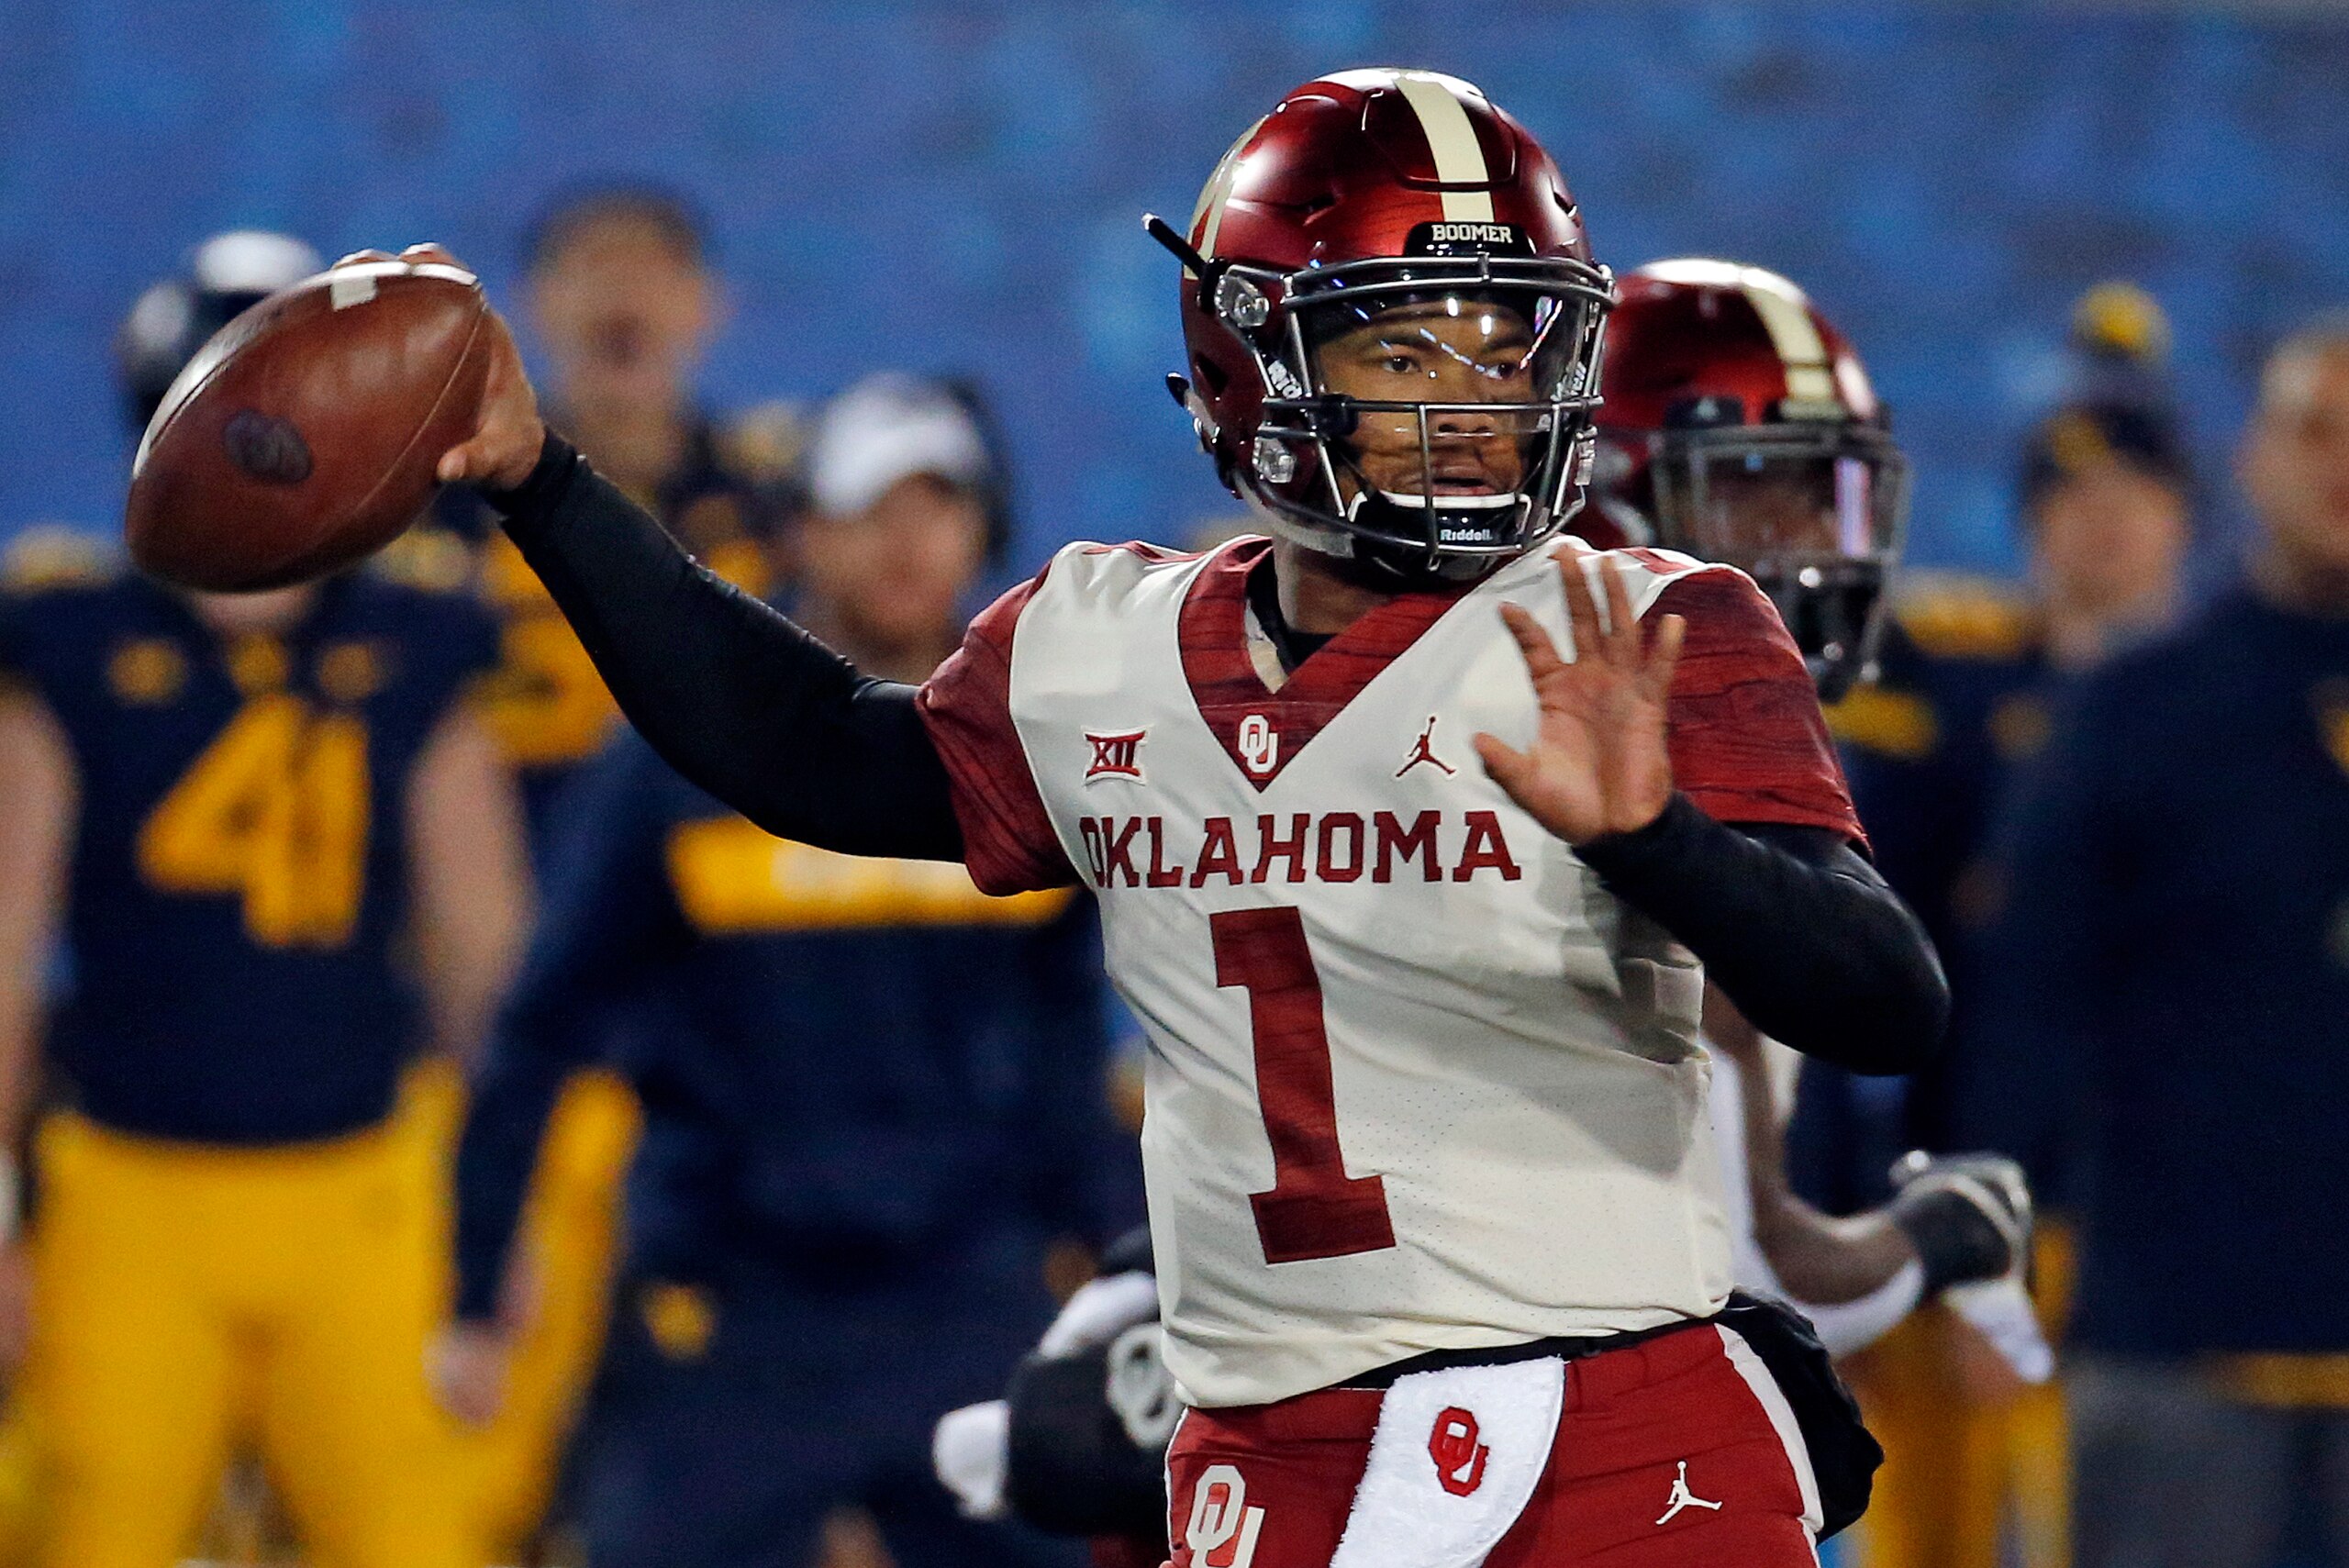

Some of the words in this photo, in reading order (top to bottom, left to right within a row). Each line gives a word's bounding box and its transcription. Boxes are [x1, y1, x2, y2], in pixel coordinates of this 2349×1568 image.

[1431, 224, 1513, 244] BOOMER
[1440, 528, 1493, 541] Riddell
[1239, 715, 1278, 773] OU
[138, 695, 370, 947] 41
[1079, 810, 1521, 888] OKLAHOMA
[1209, 906, 1397, 1265] 1
[1428, 1406, 1490, 1497] OU
